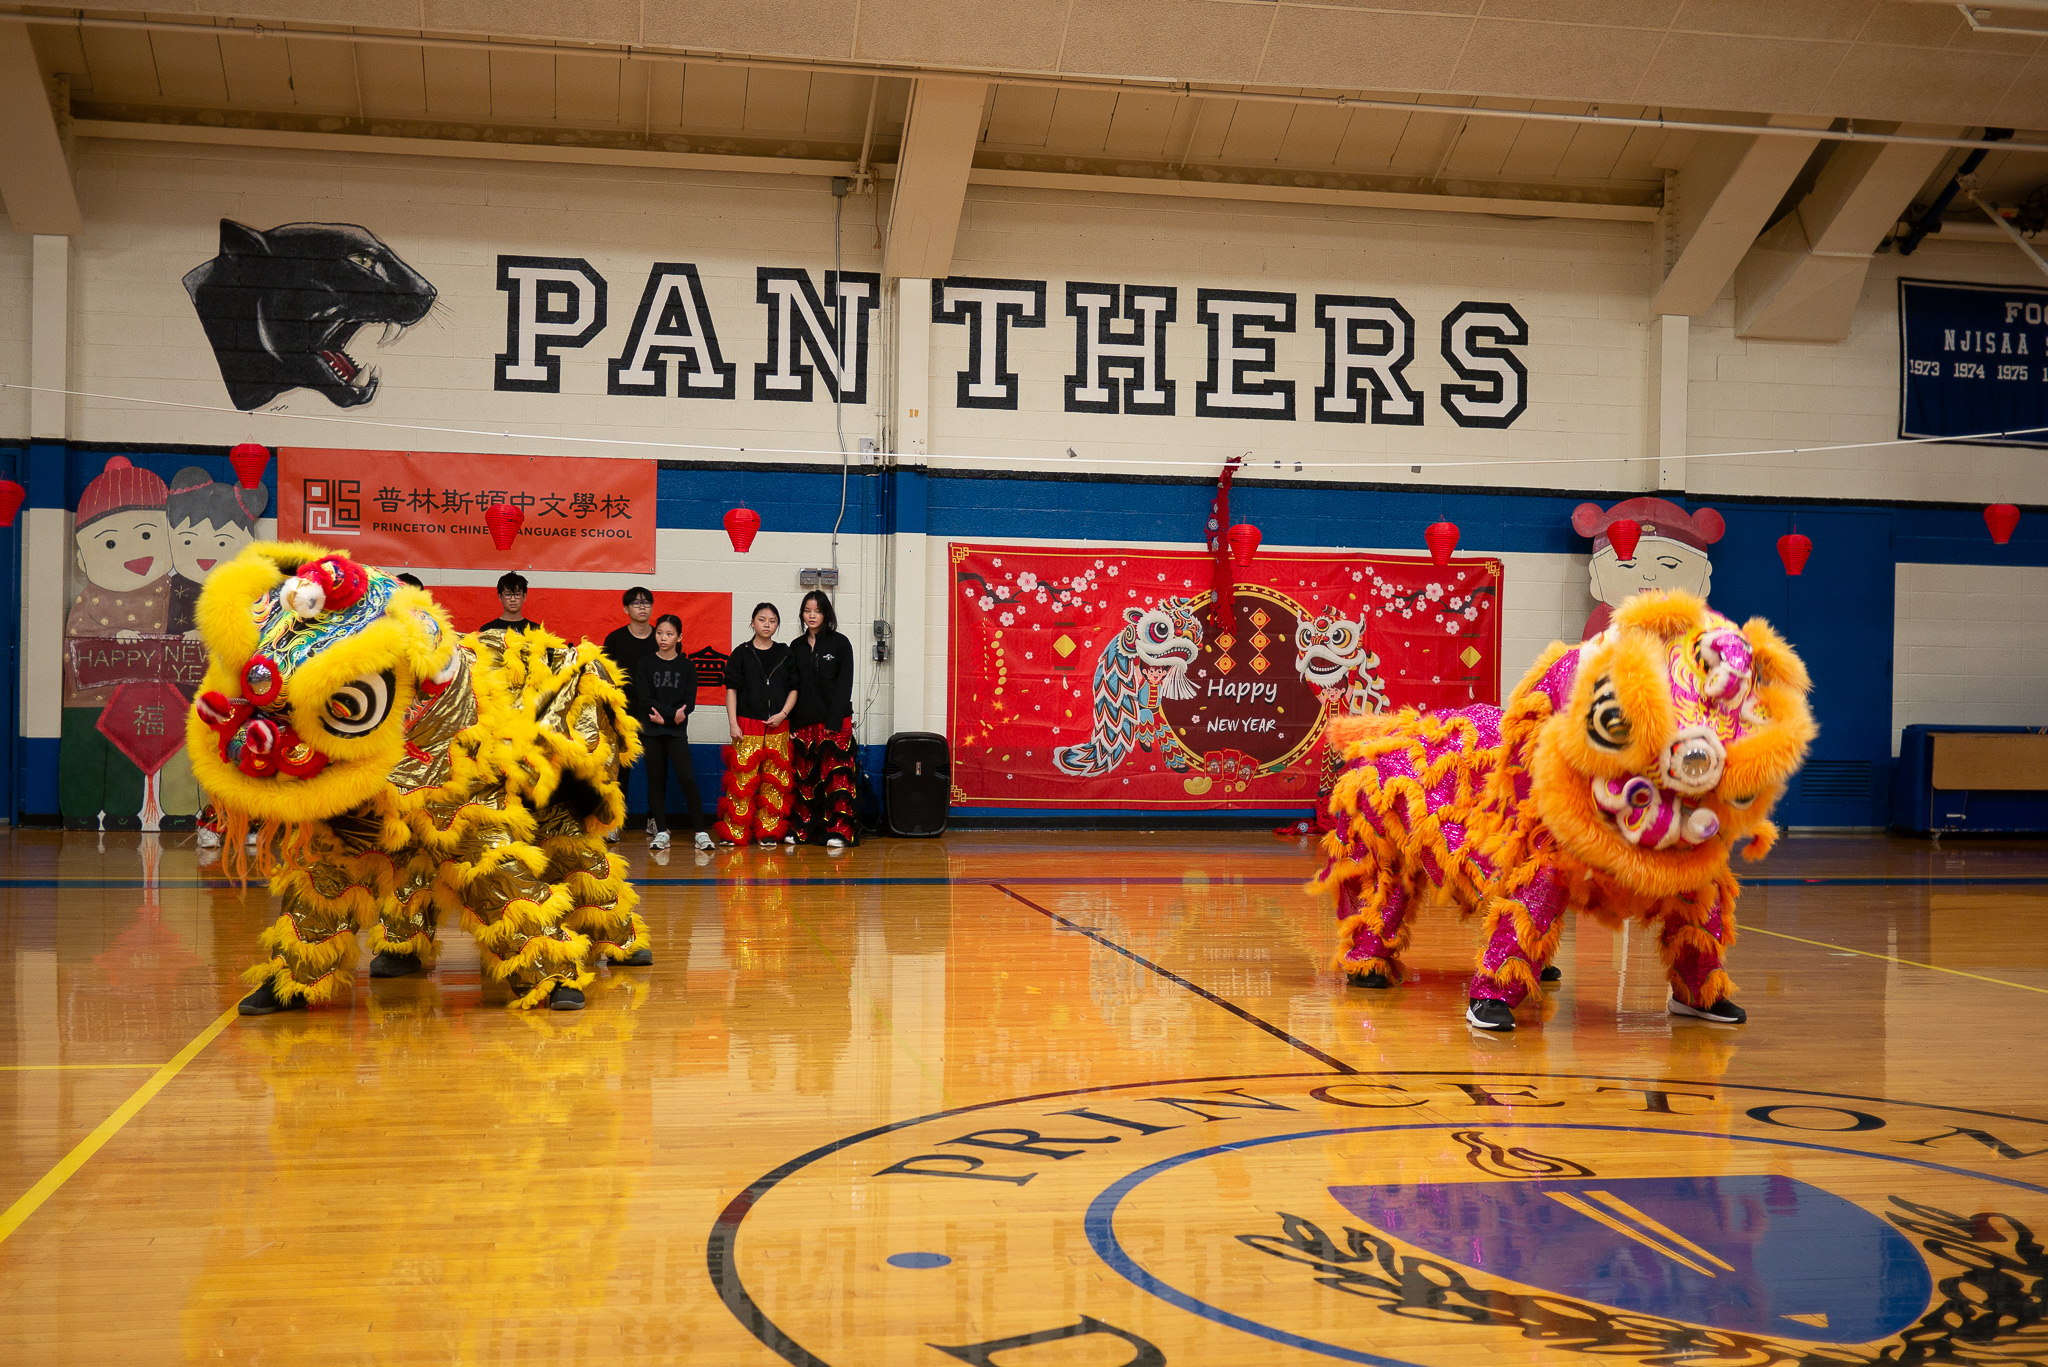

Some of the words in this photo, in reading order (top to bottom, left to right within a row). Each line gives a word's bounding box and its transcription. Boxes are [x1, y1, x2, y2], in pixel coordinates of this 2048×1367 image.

[2005, 302, 2048, 326] FO
[1944, 329, 2029, 355] NJISAA
[1909, 359, 1940, 376] 1973
[1953, 362, 1985, 379] 1974
[1997, 365, 2029, 381] 1975
[373, 486, 633, 520] 普林斯頓中文學校
[372, 522, 447, 535] PRINCETON
[450, 524, 490, 535] CHINE
[517, 526, 577, 538] ANGUAGE
[580, 528, 633, 539] SCHOOL
[77, 649, 156, 668] HAPPY
[171, 664, 203, 682] YE
[1207, 678, 1278, 705] Happy
[132, 704, 166, 737] 福
[1206, 716, 1240, 734] NEW
[1242, 716, 1277, 734] YEAR
